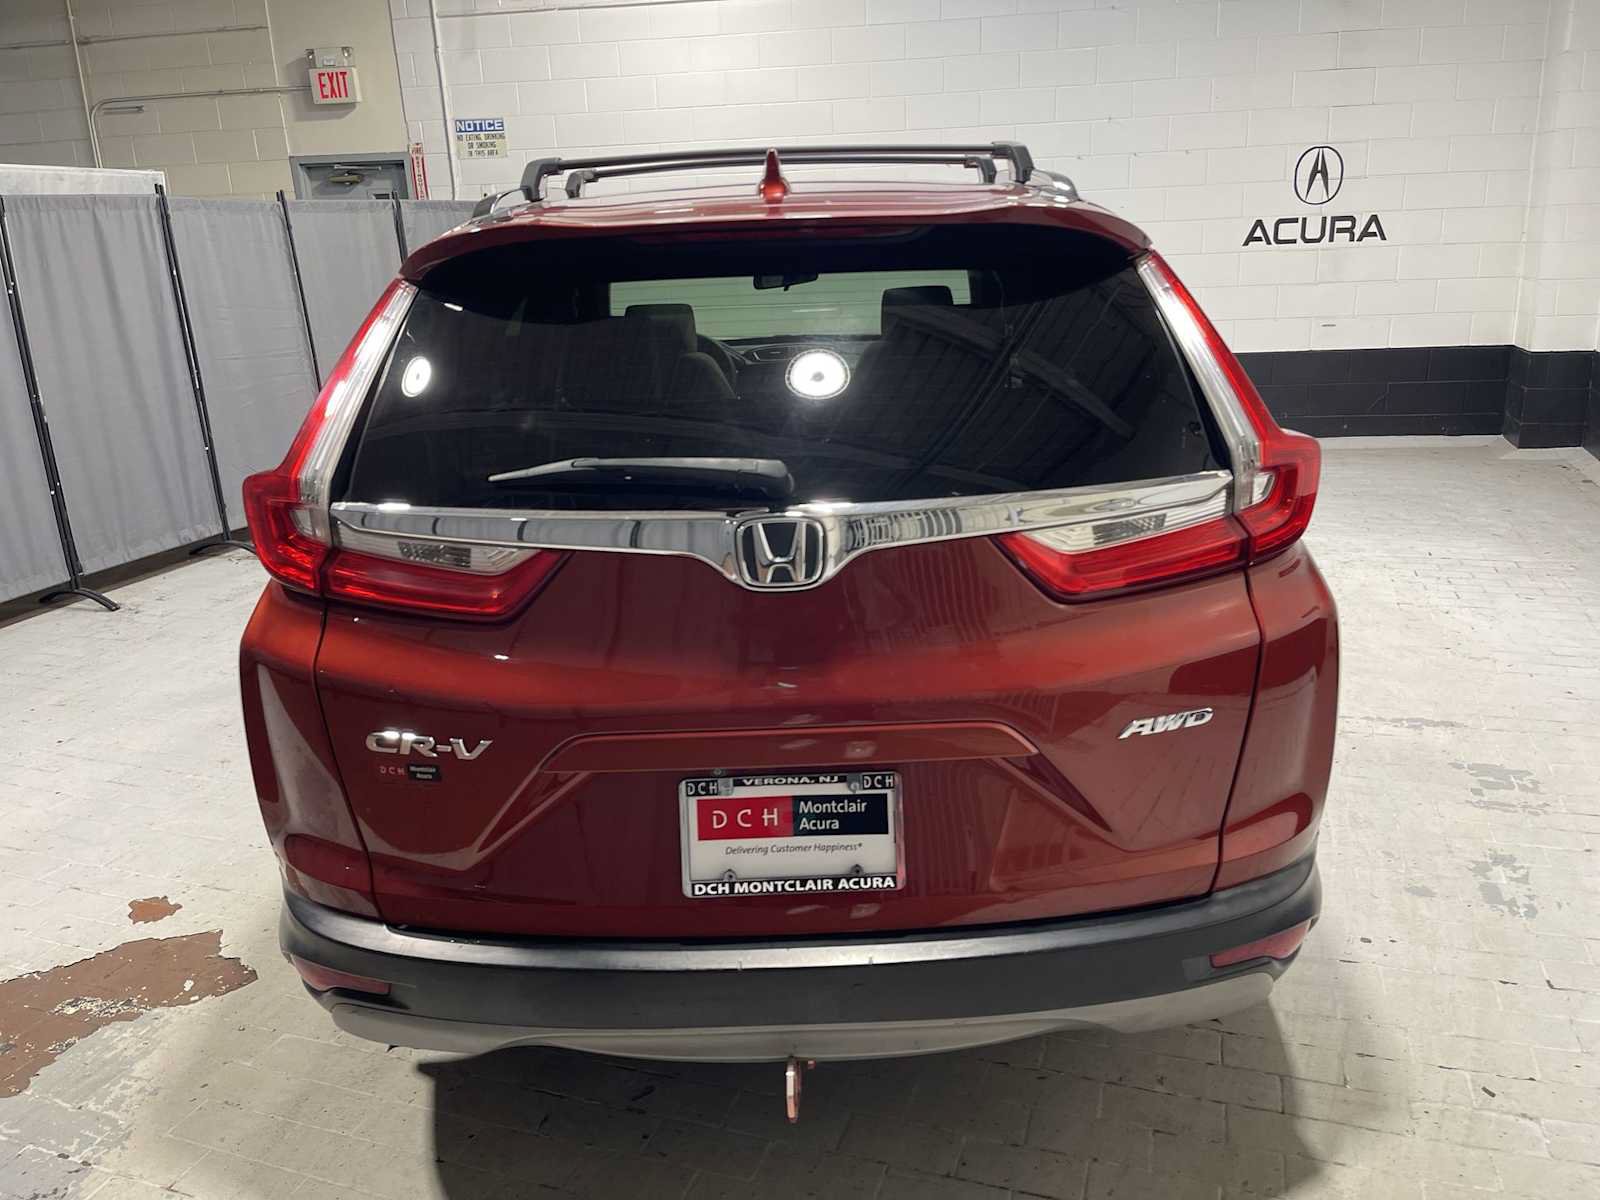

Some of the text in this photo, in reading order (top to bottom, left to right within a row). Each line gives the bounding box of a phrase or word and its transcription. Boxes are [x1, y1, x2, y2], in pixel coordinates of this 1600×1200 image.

[318, 71, 349, 99] EXIT
[456, 119, 504, 132] NOTICE
[1242, 214, 1387, 246] ACURA
[1117, 706, 1214, 740] AWD
[365, 728, 493, 761] CR-V
[818, 775, 839, 784] NJ
[799, 800, 867, 814] Montclair
[799, 817, 840, 830] Acura
[725, 845, 769, 856] Delivering
[770, 843, 812, 854] Customer
[694, 876, 895, 896] DCH MONTCLAIR ACURA
